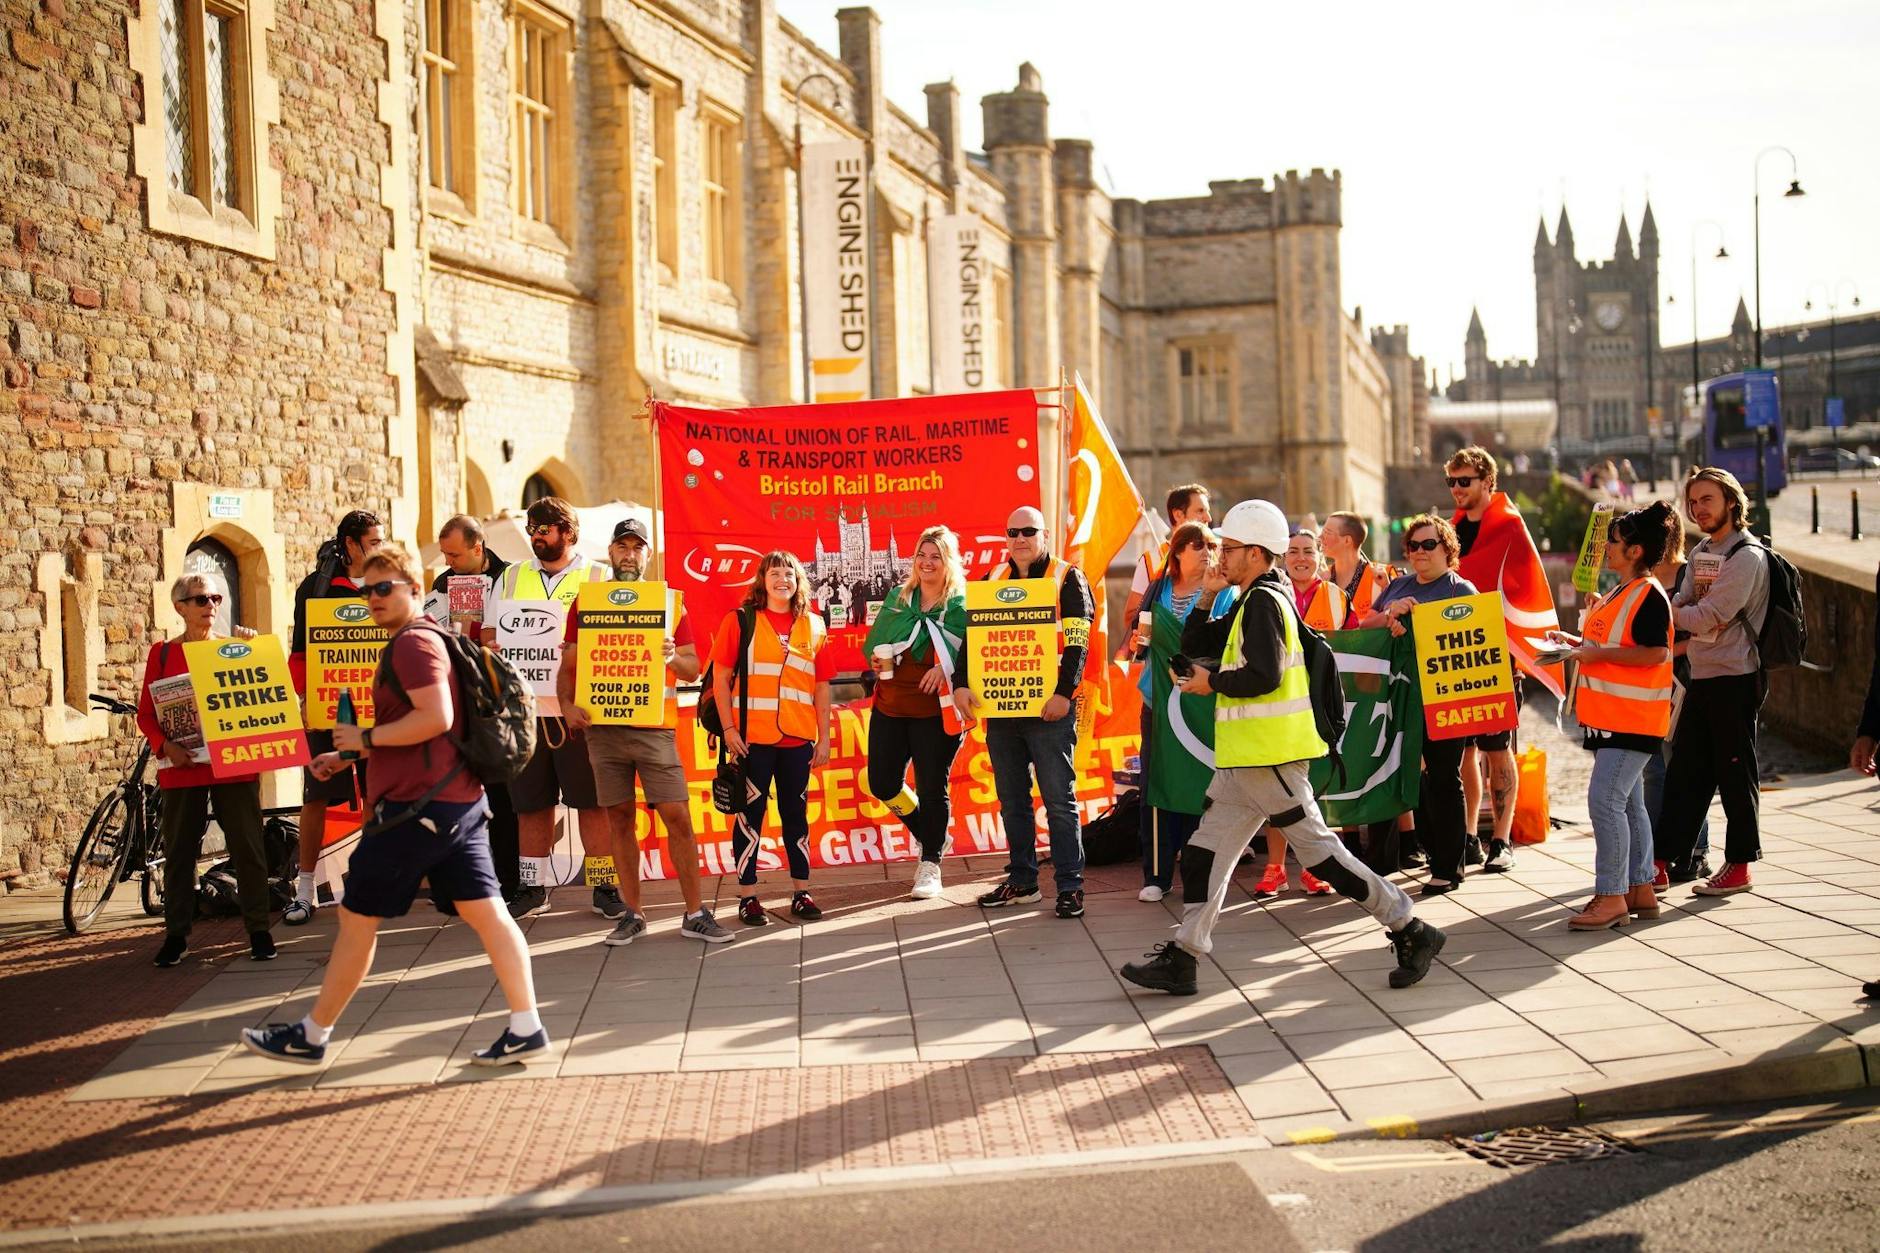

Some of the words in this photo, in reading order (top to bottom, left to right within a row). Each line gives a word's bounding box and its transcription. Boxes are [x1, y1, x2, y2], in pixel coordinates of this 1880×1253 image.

[835, 158, 862, 266] ENGINE
[957, 229, 980, 317] ENGINE
[840, 274, 865, 352] SHED
[962, 323, 982, 387] SHED
[685, 421, 781, 446] NATIONAL
[785, 427, 842, 446] UNION
[846, 426, 870, 445] OF
[875, 425, 921, 444] RAIL,
[926, 417, 1009, 441] MARITIME
[738, 449, 751, 468] &
[756, 449, 867, 470] TRANSPORT
[873, 444, 963, 468] WORKERS
[759, 473, 828, 496] Bristol
[833, 473, 869, 495] Rail
[874, 469, 944, 494] Branch
[770, 501, 815, 521] FOR
[962, 548, 1010, 566] RMT
[701, 557, 752, 574] RMT
[1001, 591, 1022, 599] RMT
[343, 609, 366, 617] RMT
[583, 614, 626, 624] OFFICIAL
[628, 614, 662, 624] PICKET
[972, 611, 1015, 623] OFFICIAL
[1018, 610, 1052, 621] PICKET
[1449, 606, 1468, 617] RMT
[511, 617, 547, 628] RMT
[313, 629, 345, 641] CROSS
[347, 628, 393, 640] COUNTR
[597, 634, 645, 647] NEVER
[843, 632, 867, 649] TH
[987, 630, 1036, 643] NEVER
[1068, 636, 1088, 648] PICKE
[1435, 628, 1486, 651] THIS
[225, 646, 248, 655] RMT
[319, 648, 381, 664] TRAININ
[501, 647, 558, 661] OFFICIAL
[590, 649, 637, 662] CROSS
[641, 649, 652, 662] A
[980, 645, 1029, 658] CROSS
[1033, 644, 1044, 656] A
[984, 658, 1041, 673] PICKET!
[1426, 647, 1502, 675] STRIKE
[213, 666, 269, 688] THIS
[323, 668, 376, 684] KEEP
[519, 668, 552, 682] CKET
[592, 665, 648, 677] PICKET!
[590, 682, 623, 694] YOUR
[626, 682, 650, 694] JOB
[982, 677, 1016, 688] YOUR
[1020, 676, 1044, 687] JOB
[1436, 682, 1449, 696] is
[1453, 674, 1499, 693] about
[206, 685, 288, 711] STRIKE
[590, 695, 633, 706] COULD
[634, 695, 649, 706] BE
[983, 689, 1024, 700] COULD
[1028, 688, 1043, 698] BE
[162, 701, 194, 719] STRIKE
[326, 704, 375, 721] SFE
[603, 708, 635, 718] NEXT
[997, 700, 1029, 711] NEXT
[219, 718, 233, 732] is
[239, 712, 286, 729] about
[1436, 701, 1507, 728] SAFETY
[221, 738, 298, 764] SAFETY
